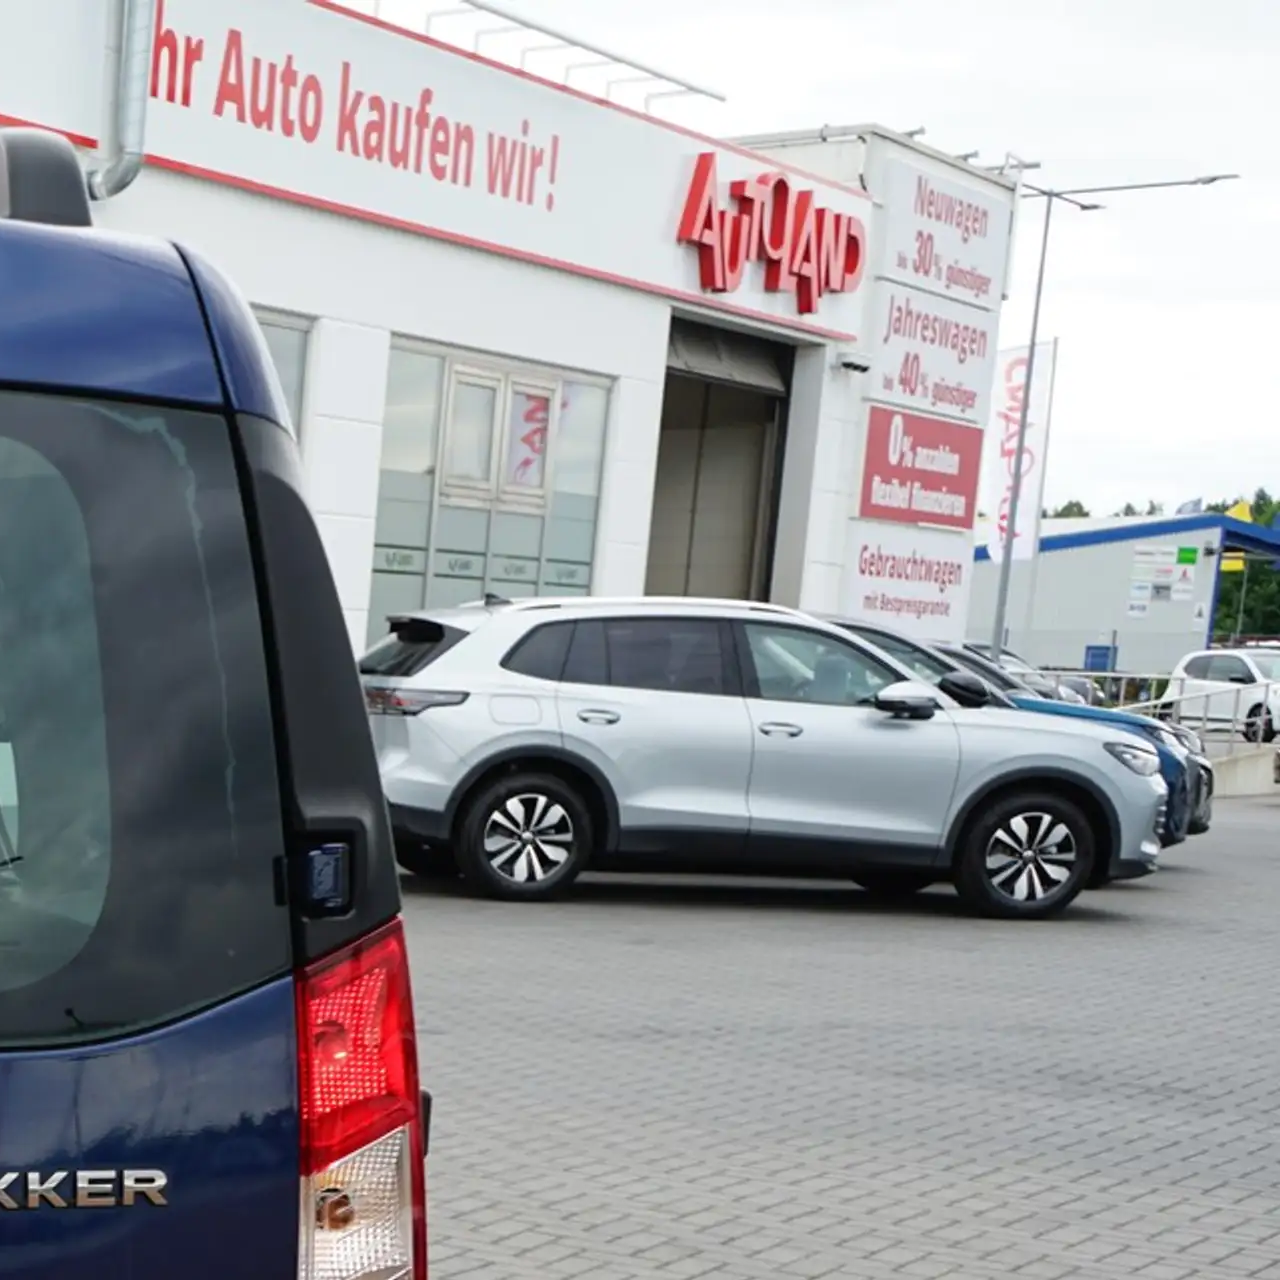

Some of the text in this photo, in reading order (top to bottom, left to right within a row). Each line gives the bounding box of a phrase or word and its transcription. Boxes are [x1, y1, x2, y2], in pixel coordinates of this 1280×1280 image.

[149, 0, 204, 108] hr
[213, 28, 324, 143] Auto
[335, 61, 474, 187] kaufen
[676, 152, 866, 314] AUTOLAND
[914, 175, 989, 244] Neuwagen
[883, 295, 988, 364] Jahreswagen
[858, 544, 963, 593] Gebrauchtwagen
